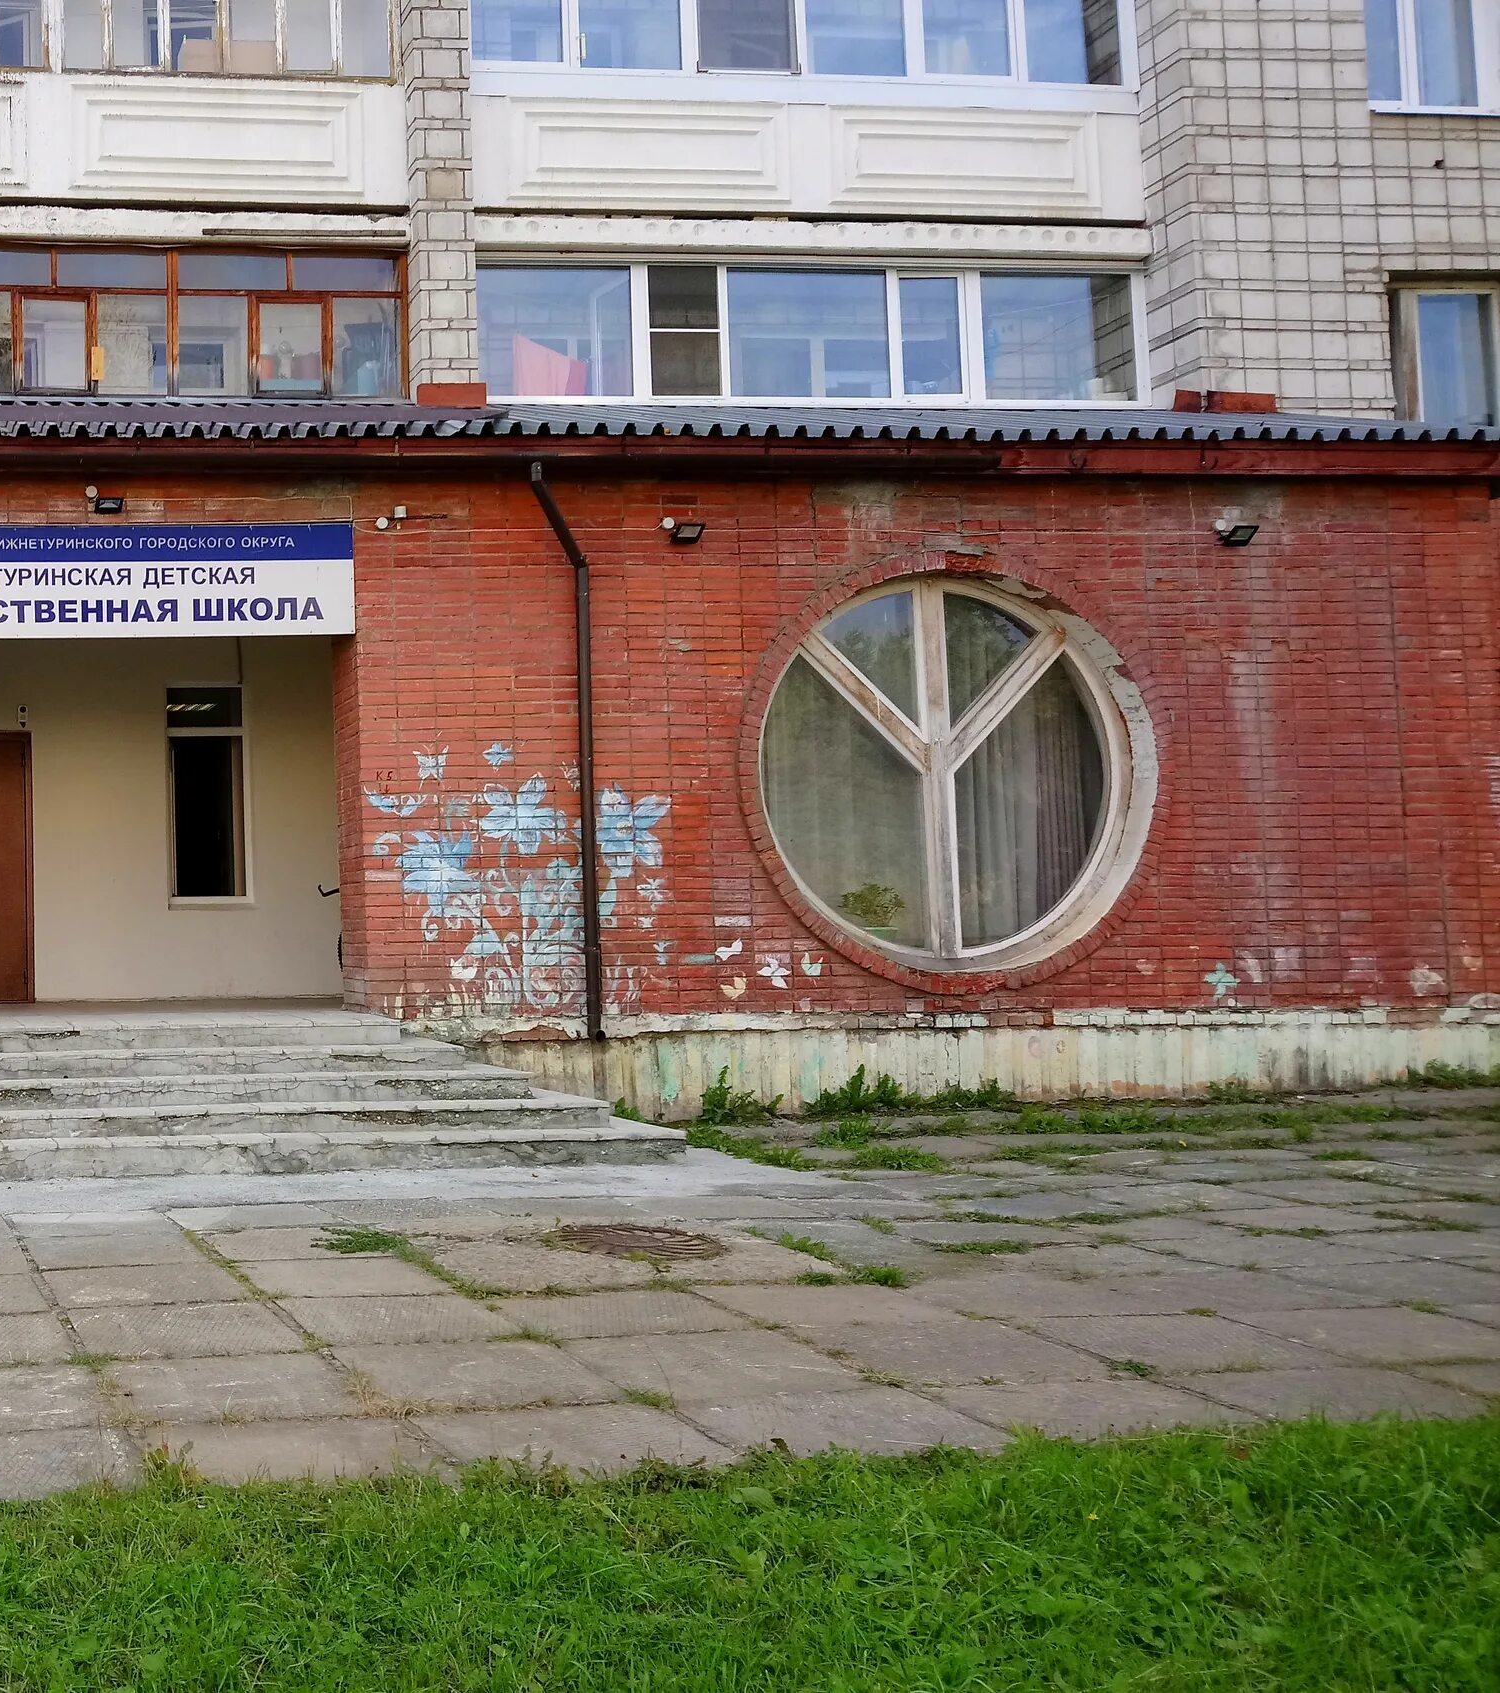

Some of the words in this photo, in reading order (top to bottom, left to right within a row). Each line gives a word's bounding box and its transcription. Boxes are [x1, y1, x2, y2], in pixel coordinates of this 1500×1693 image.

[139, 537, 236, 551] ГОРОДСКОГО
[241, 536, 295, 549] ОКРУГА
[143, 567, 255, 589] ДЕТСКАЯ
[192, 597, 324, 622] ШКОЛА
